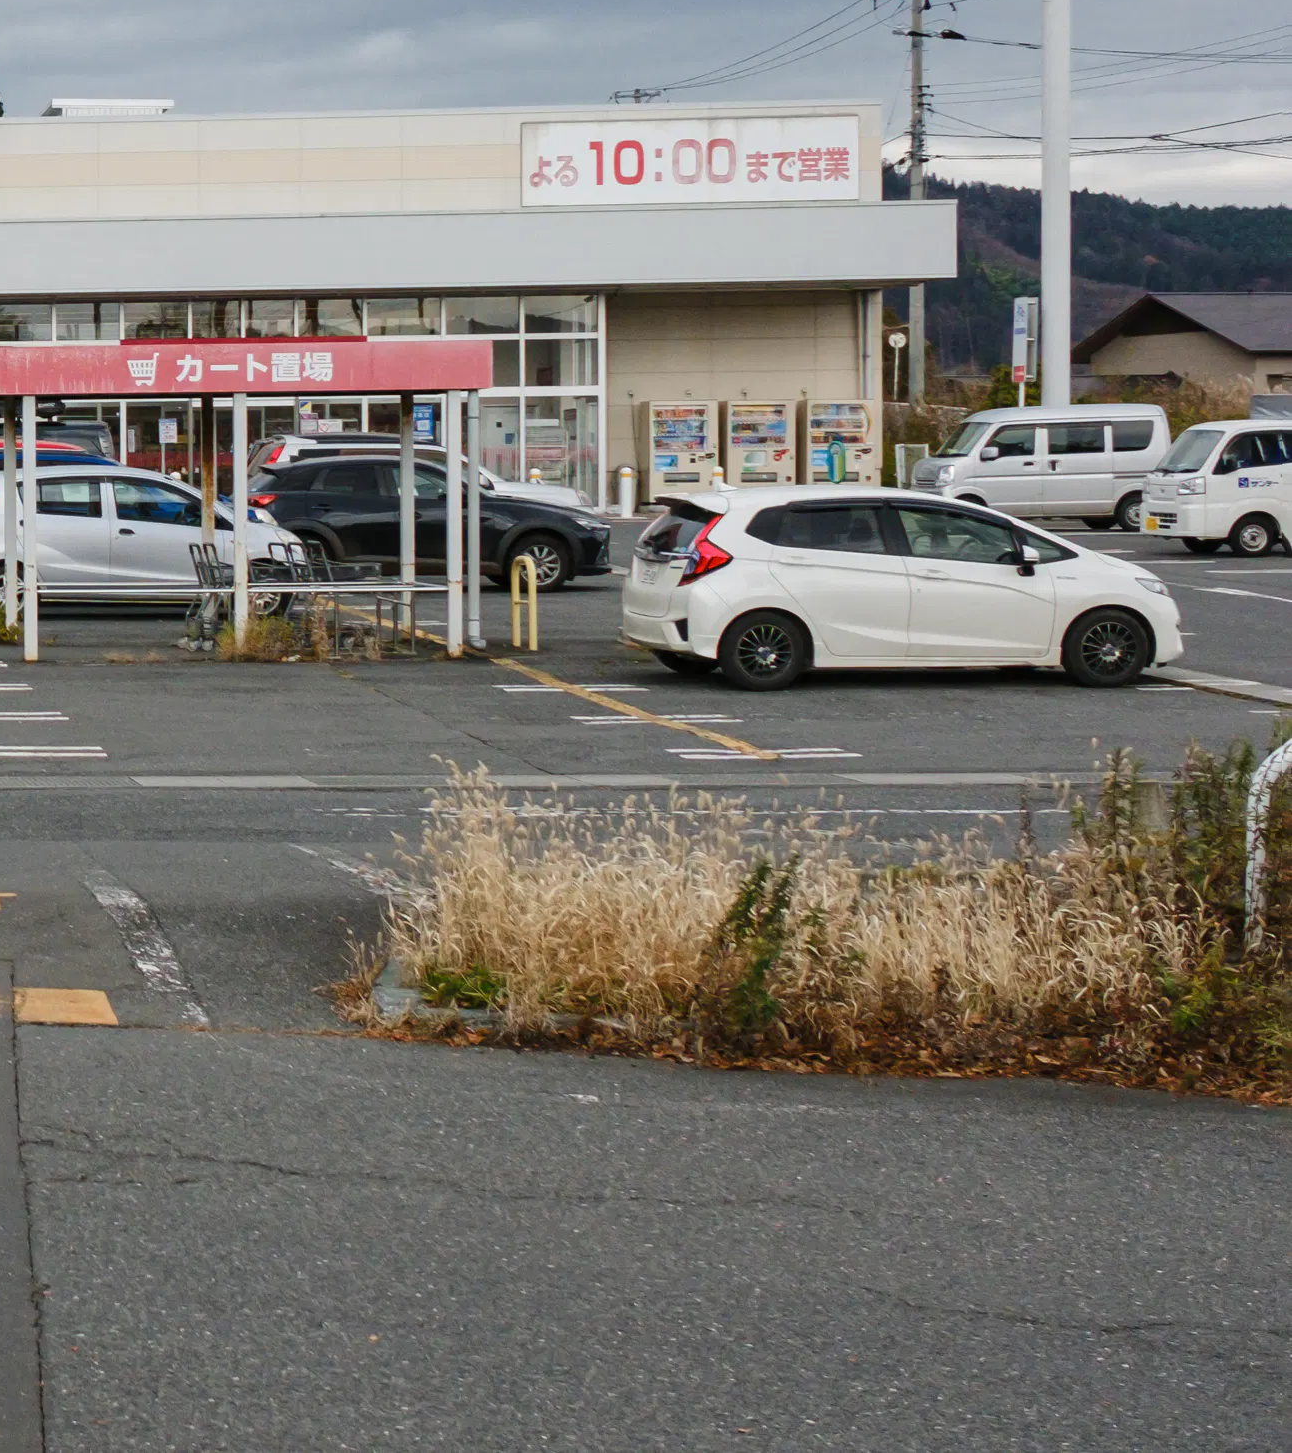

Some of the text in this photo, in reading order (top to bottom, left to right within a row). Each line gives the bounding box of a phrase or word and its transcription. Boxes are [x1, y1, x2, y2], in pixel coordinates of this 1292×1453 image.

[175, 352, 333, 382] カート置場
